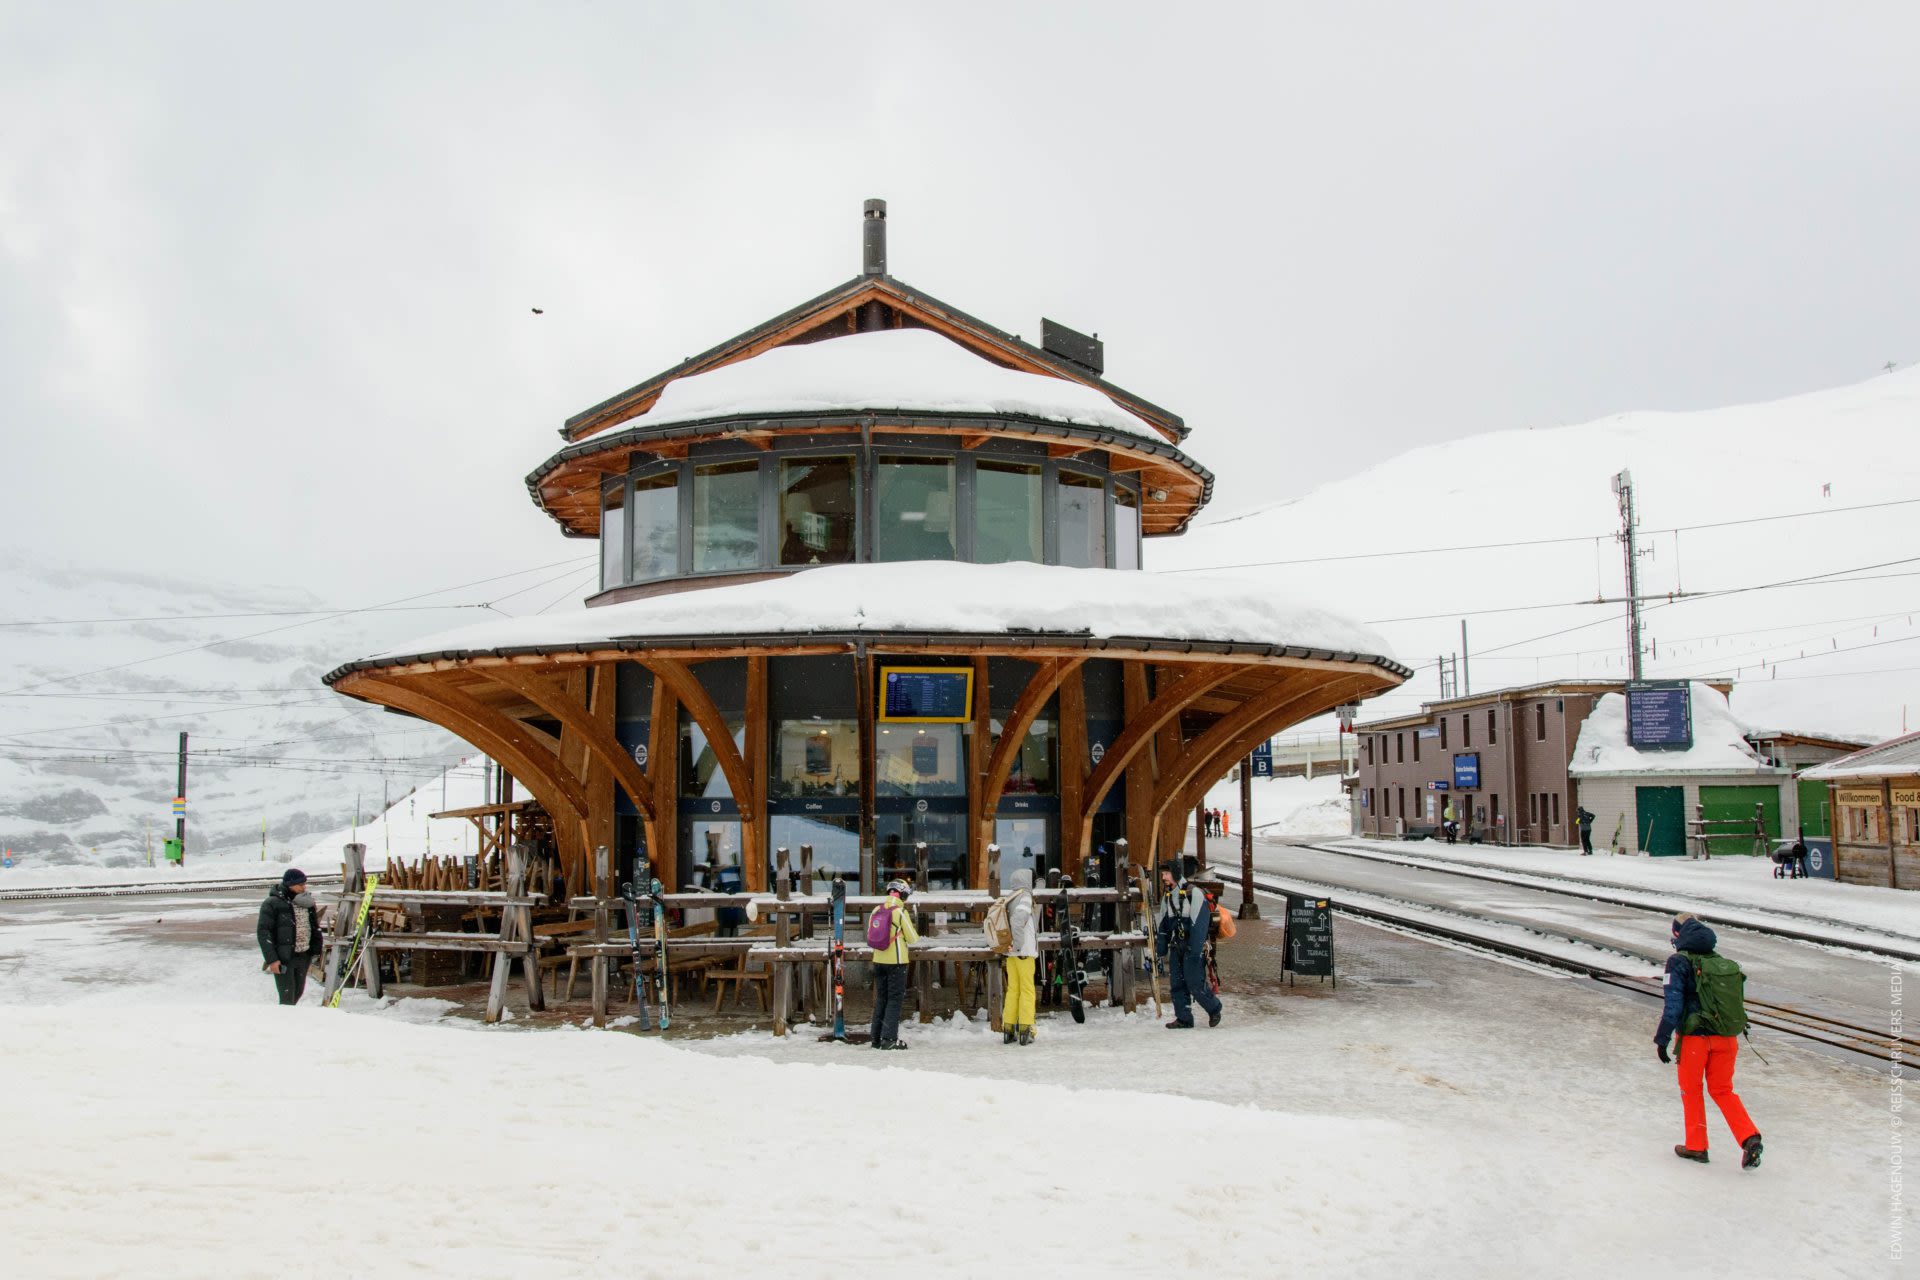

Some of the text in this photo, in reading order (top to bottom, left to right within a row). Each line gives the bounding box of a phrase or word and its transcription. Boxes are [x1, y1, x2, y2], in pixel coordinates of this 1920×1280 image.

[1258, 761, 1267, 772] B
[1839, 792, 1880, 803] Willkommen
[1895, 791, 1915, 802] Food
